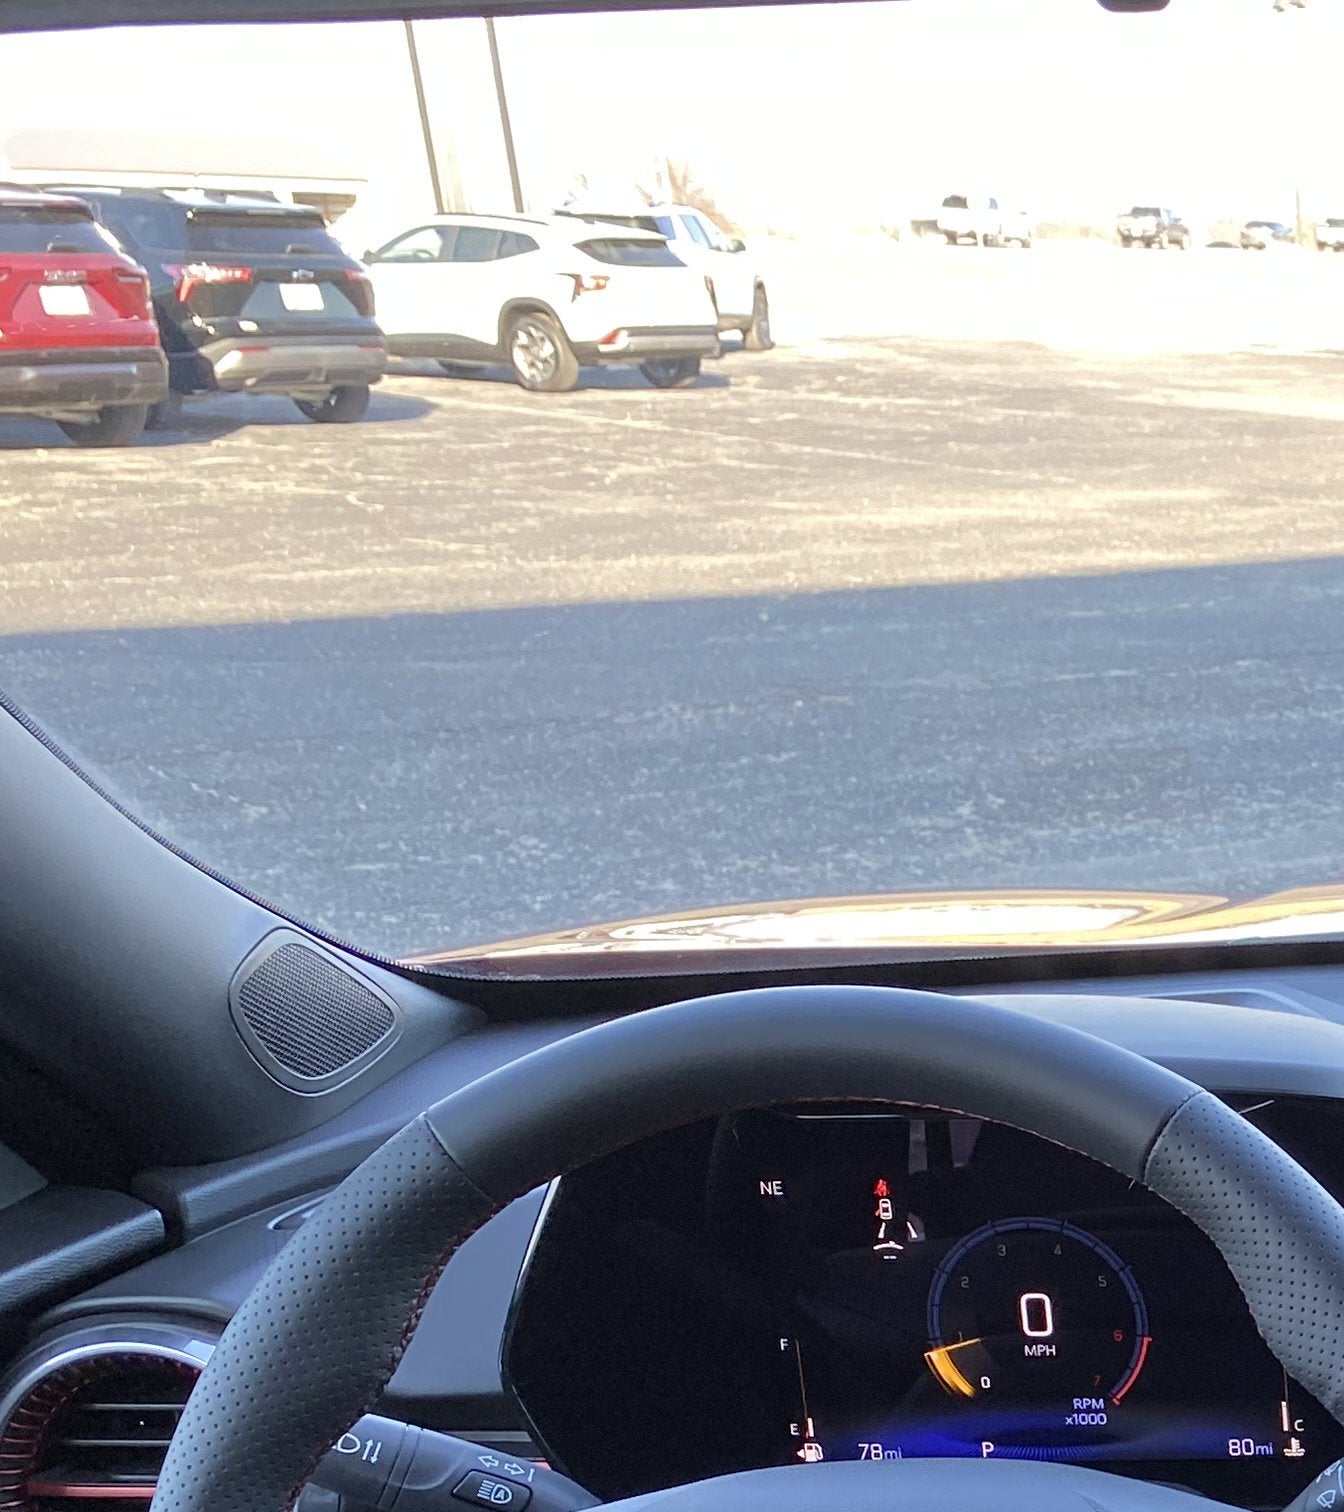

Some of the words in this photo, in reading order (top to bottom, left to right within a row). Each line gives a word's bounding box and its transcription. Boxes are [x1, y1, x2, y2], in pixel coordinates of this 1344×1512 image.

[760, 1181, 783, 1195] NE
[1020, 1293, 1053, 1337] 0
[780, 1339, 789, 1351] F
[1024, 1345, 1056, 1356] MPH
[981, 1376, 991, 1389] 0
[1073, 1398, 1104, 1409] RPM
[1065, 1413, 1107, 1425] x1000
[1294, 1419, 1304, 1432] C
[790, 1423, 800, 1436] E
[982, 1441, 994, 1458] P
